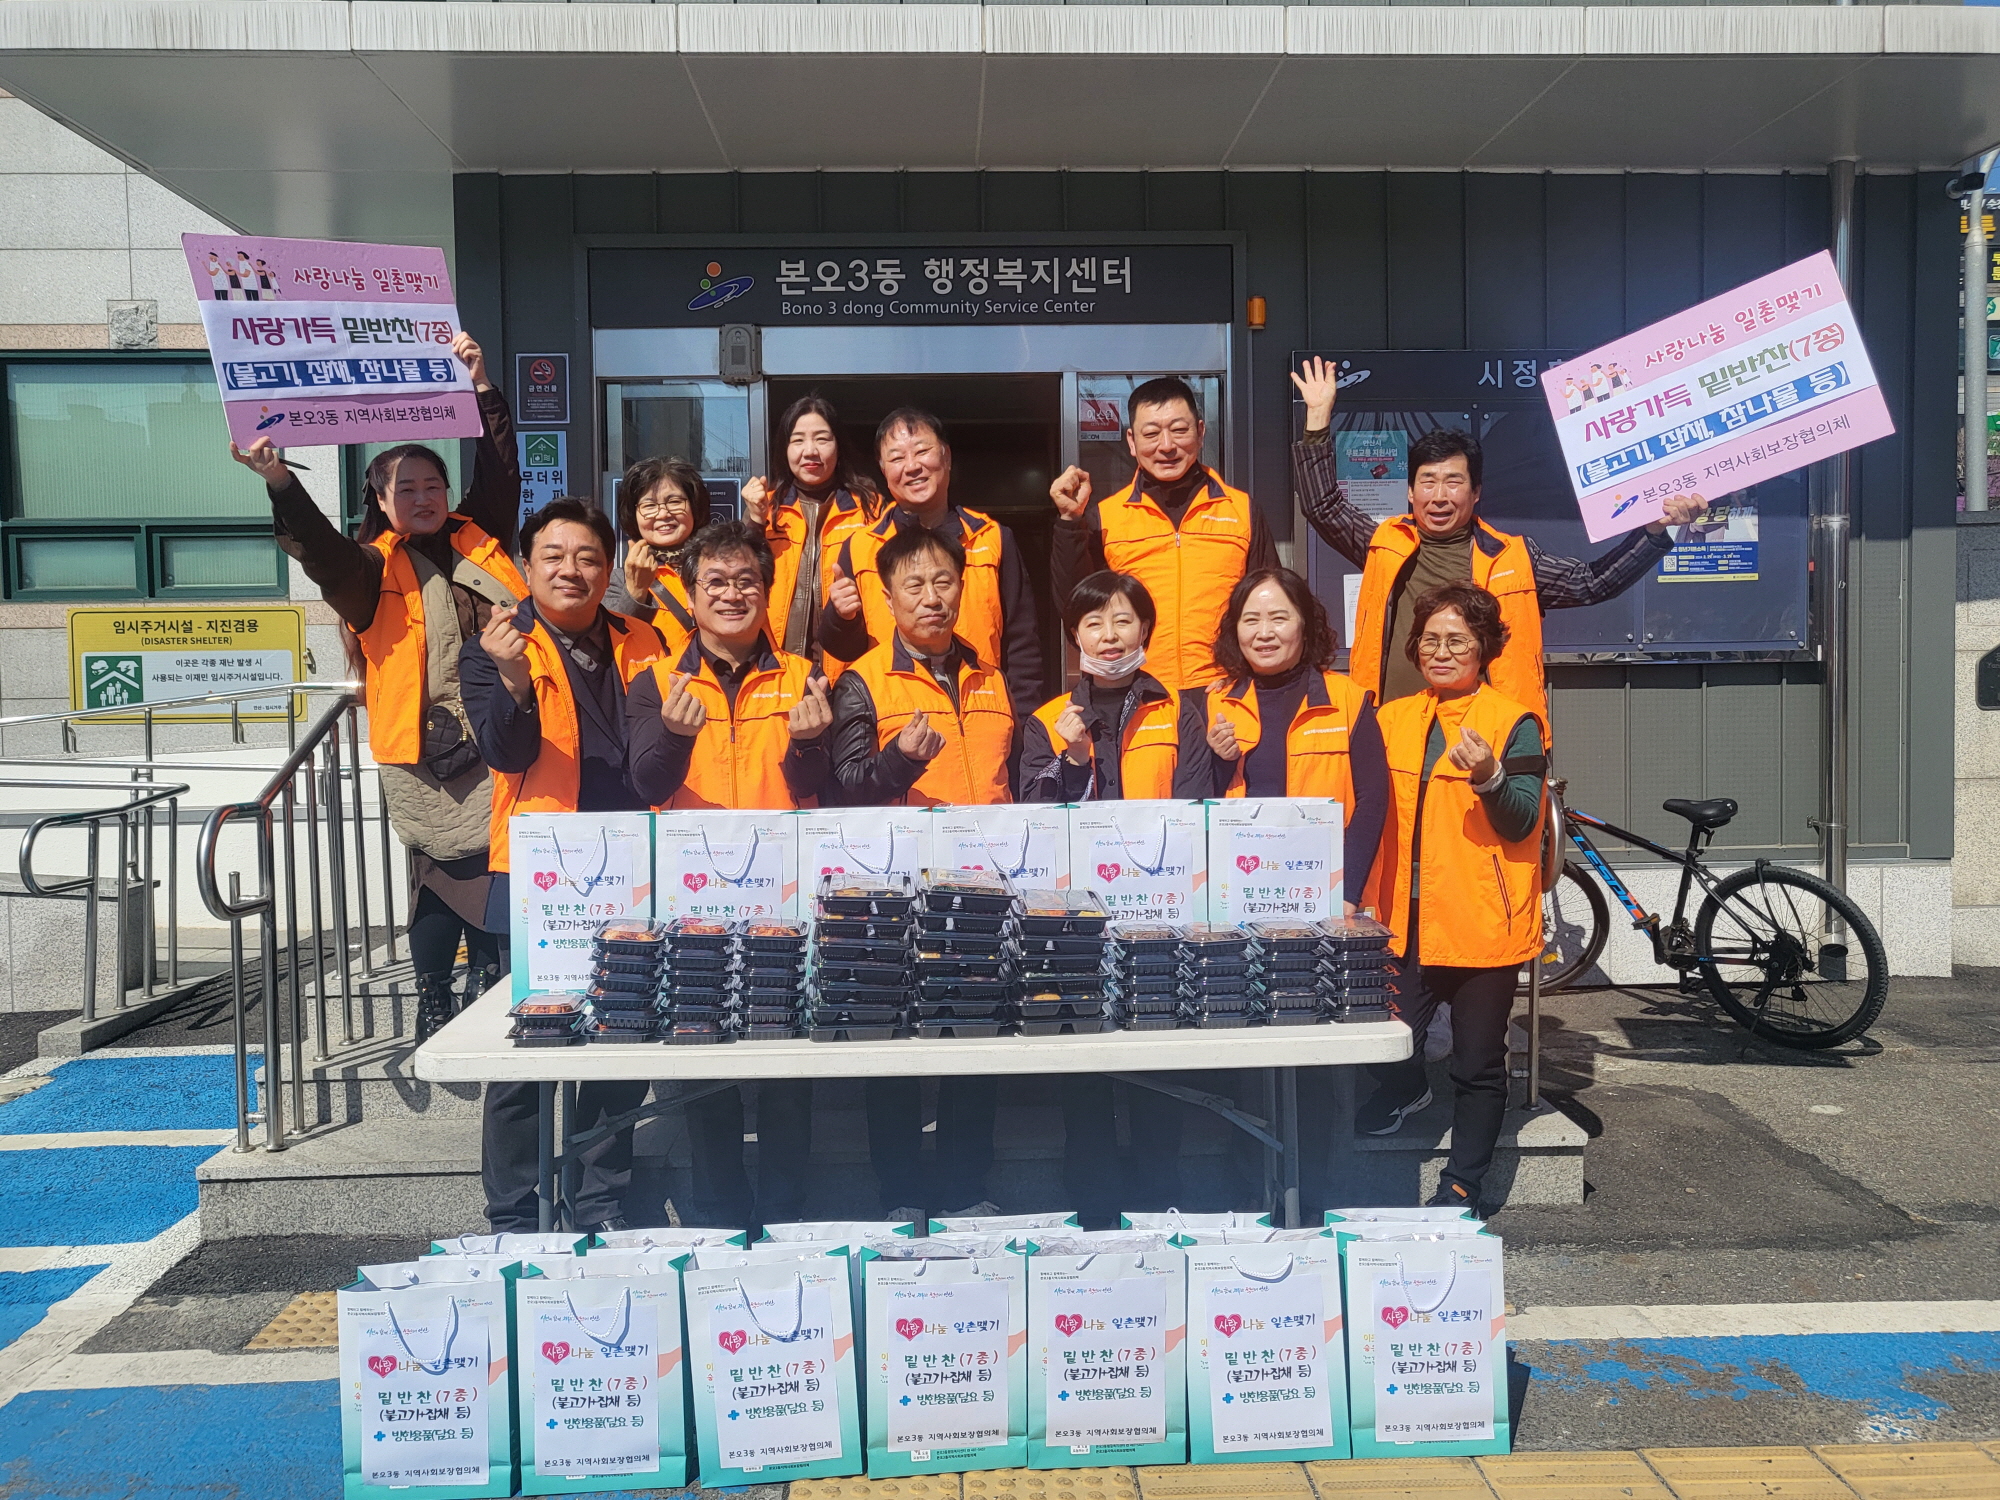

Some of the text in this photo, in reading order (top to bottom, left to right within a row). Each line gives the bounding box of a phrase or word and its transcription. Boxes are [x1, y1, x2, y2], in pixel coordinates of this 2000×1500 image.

[293, 268, 440, 294] 사랑나눔 일촌맺기
[775, 257, 1133, 295] 본오3동 행정복지센터
[782, 300, 1096, 318] Bono 3 dong Community Service Center
[232, 317, 453, 346] 사랑가득 밑반찬(7종)
[1644, 283, 1823, 369] 사랑나눔 일촌맺기
[225, 359, 455, 388] (불고기, 잡채, 참나물 등)
[1584, 322, 1846, 442] 사랑가득 밑반찬(7종)
[288, 408, 456, 428] 본오3동 지역사회보장협의체
[1579, 362, 1849, 488] (불고기, 잡채, 참나물 등)
[1642, 413, 1851, 503] 본오3동 지역사회보장협의체
[112, 620, 193, 634] 임시주거시설
[206, 619, 259, 633] 지진겸용
[141, 636, 233, 646] (DISASTER SHELTER)
[175, 658, 262, 667] 이곳은 각종 재난 발생 시
[152, 672, 283, 682] 사용되는 이재민 임시주거시설입니다.
[1055, 1427, 1157, 1438] 본오3동 지역사회보장협의체
[1222, 1428, 1324, 1443] 본오3동 지역사회보장협의체
[1384, 1420, 1485, 1433] 본오3동 지역사회보장협의체
[897, 1429, 1000, 1443] 본오3동 지역사회보장협의체
[728, 1441, 833, 1459] 본오3동 지역사회보장협의체
[544, 1454, 650, 1468] 본오3동 지역사회보장협의체
[404, 1466, 480, 1477] 지역사회보장협의체
